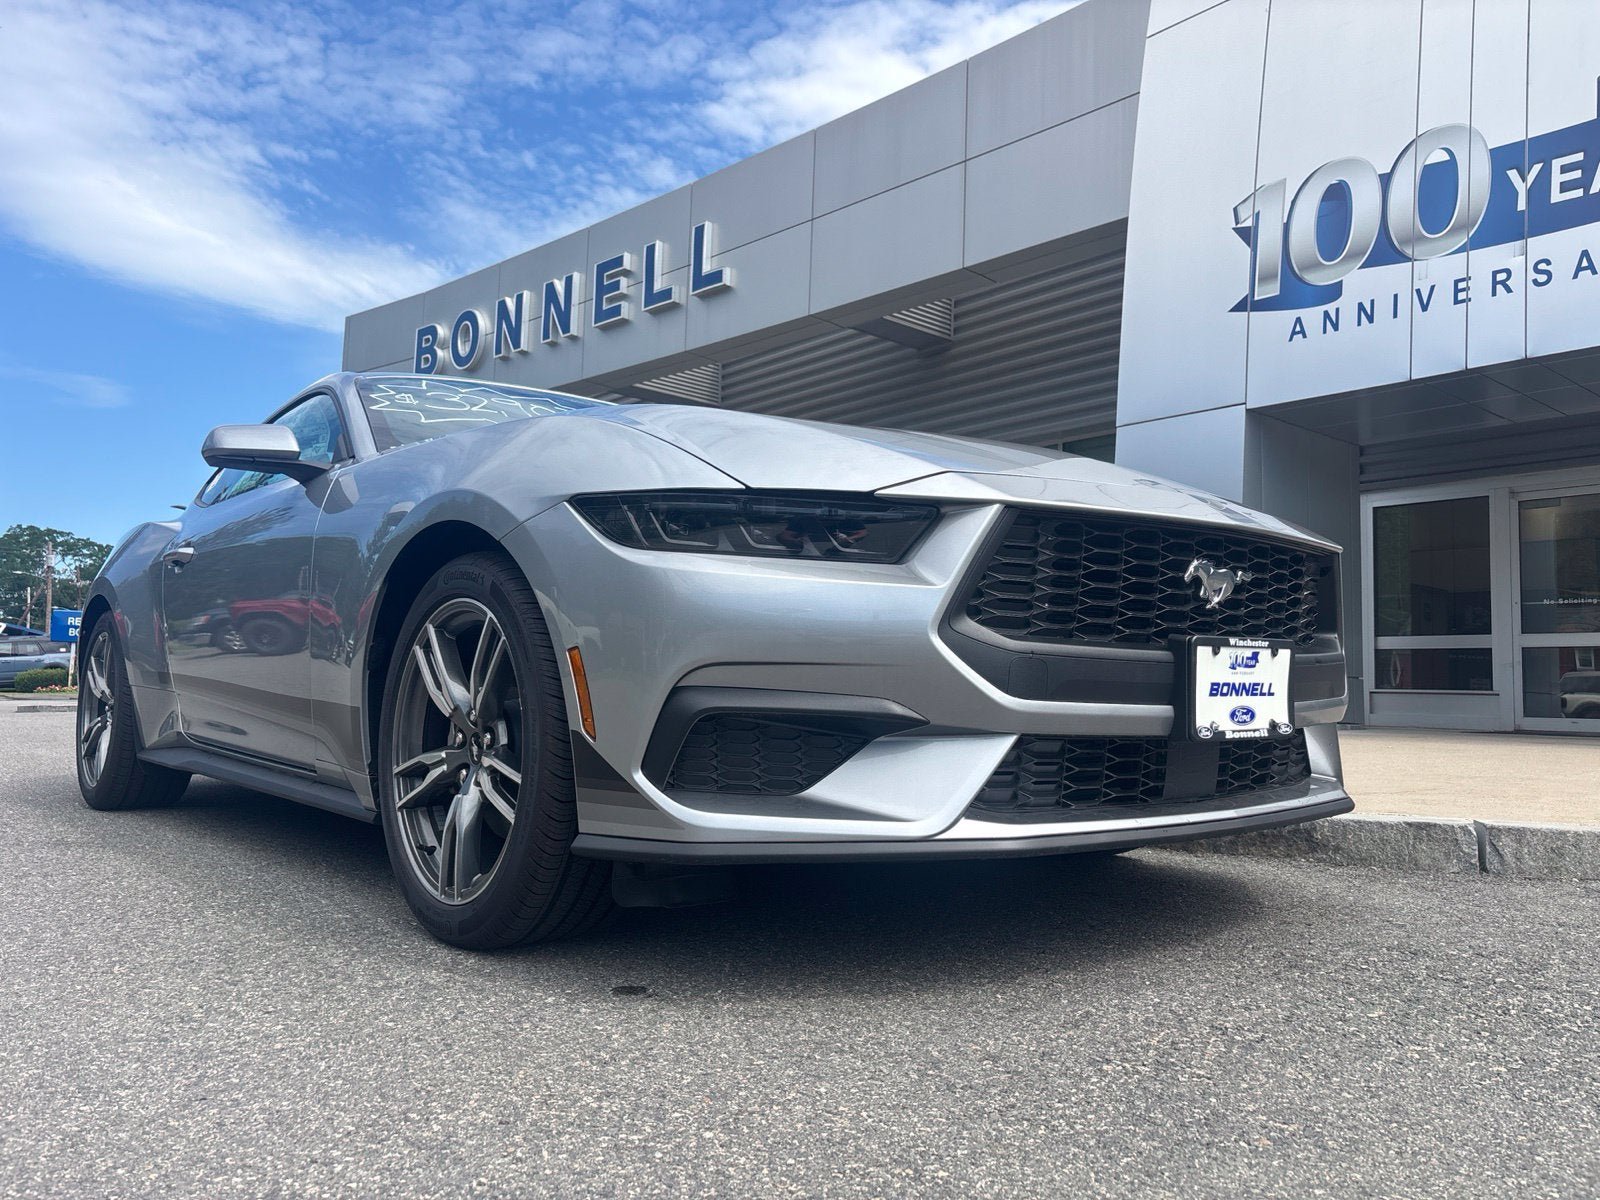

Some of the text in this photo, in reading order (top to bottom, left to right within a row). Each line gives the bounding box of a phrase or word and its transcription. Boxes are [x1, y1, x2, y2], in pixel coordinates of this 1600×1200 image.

[1232, 123, 1492, 301] 100
[413, 220, 732, 375] BONNELL
[1288, 249, 1598, 343] ANNIVERSA
[1229, 638, 1269, 647] Winchester
[1208, 682, 1275, 697] BONNELL
[1225, 729, 1268, 739] Bonnell
